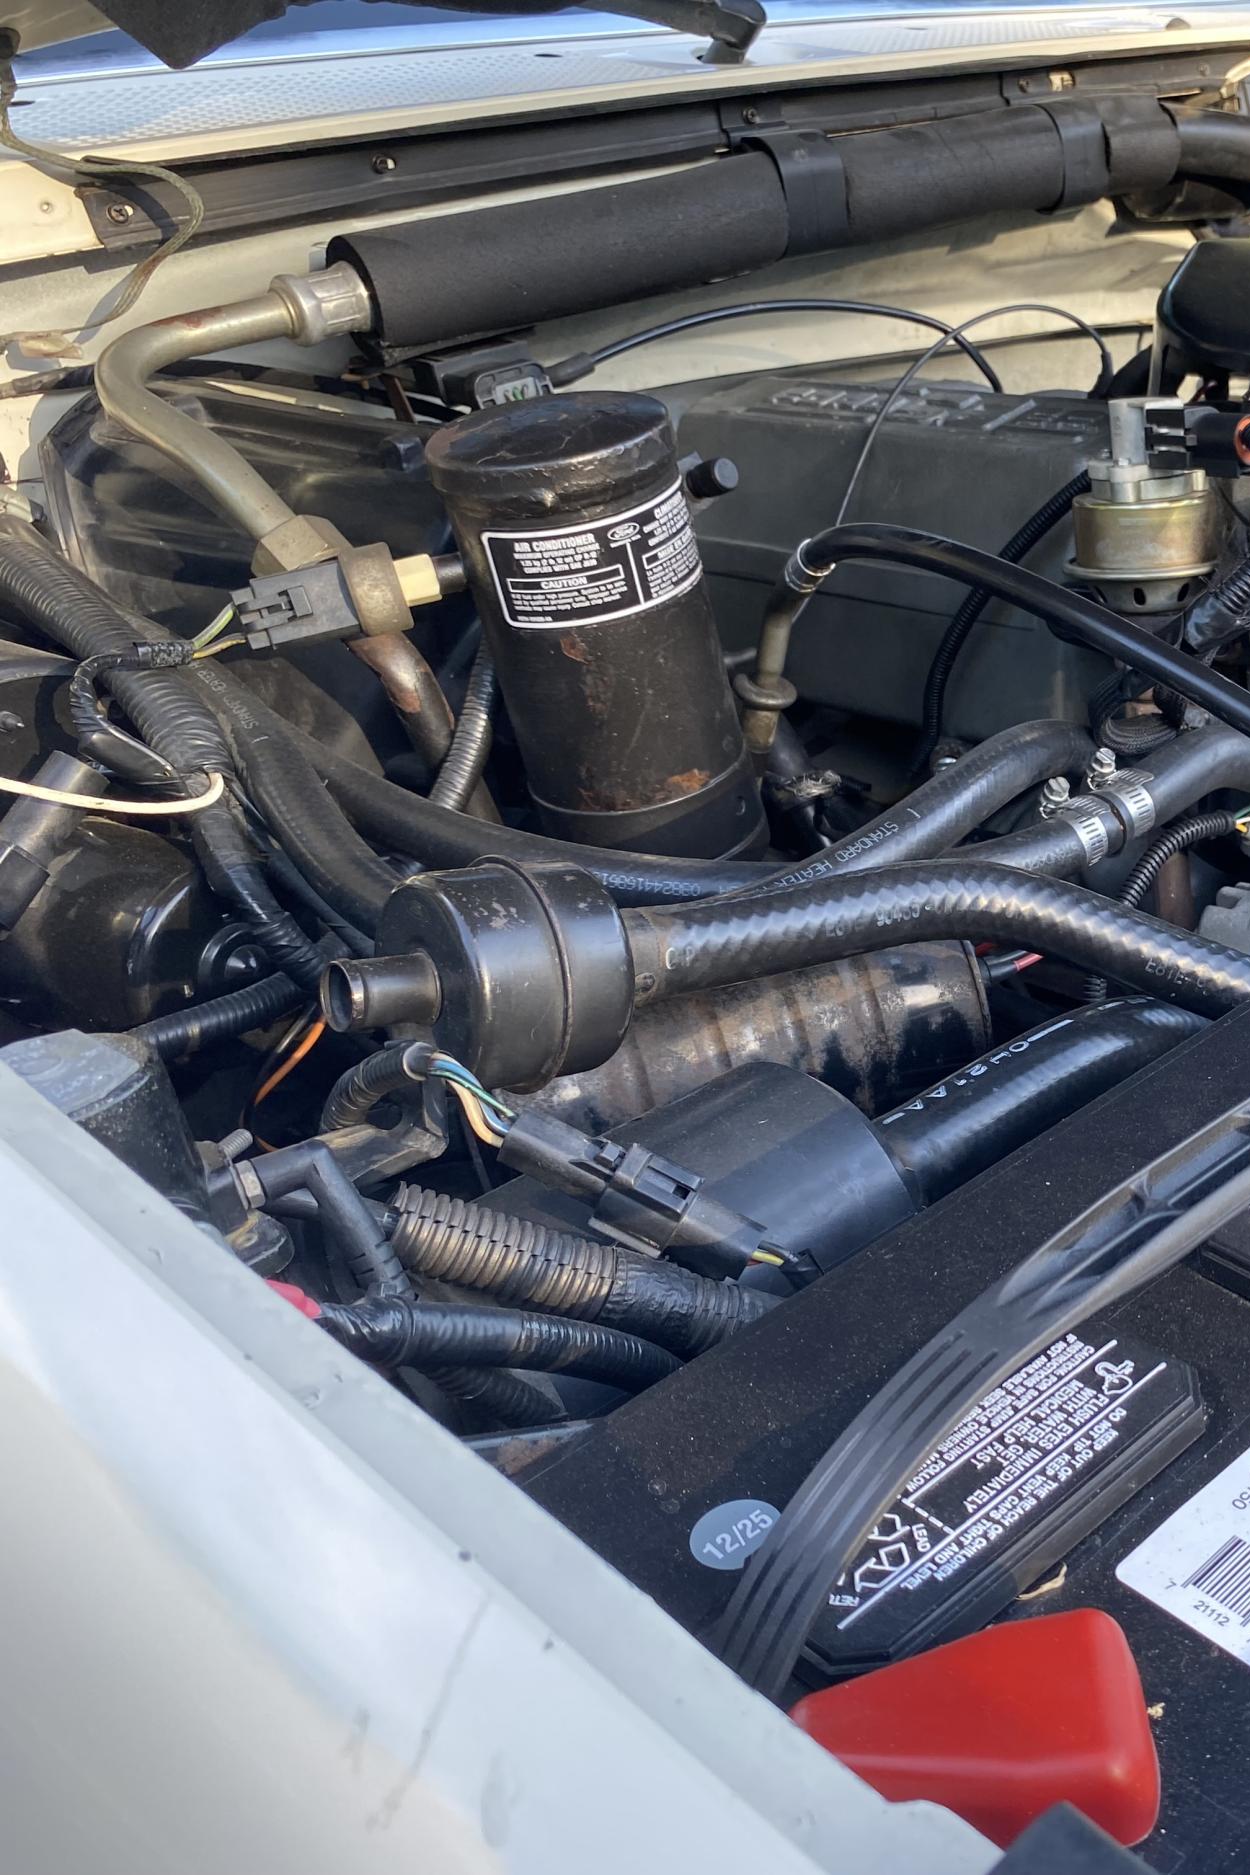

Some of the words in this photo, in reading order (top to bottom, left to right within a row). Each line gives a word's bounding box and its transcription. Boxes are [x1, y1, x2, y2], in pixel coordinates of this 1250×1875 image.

[514, 542, 531, 552] AIR
[533, 534, 597, 551] CONDITIONER
[541, 577, 587, 591] CAUTION
[835, 822, 898, 865] STANDARD
[976, 1395, 1015, 1423] VEHICLE
[1031, 1380, 1083, 1417] MEDICAL
[1060, 1387, 1096, 1416] WITH
[1069, 1394, 1109, 1426] FLUSH
[1109, 1407, 1126, 1421] DO
[1004, 1417, 1035, 1443] HELP
[1020, 1414, 1063, 1443] WATER.
[1039, 1423, 1073, 1449] EYES
[1089, 1420, 1111, 1438] NOT
[1094, 1429, 1118, 1450] KEEP
[943, 1426, 990, 1461] STARTING
[971, 1441, 1004, 1469] FAST
[996, 1444, 1023, 1466] GET
[1046, 1453, 1071, 1475] KEEP
[1071, 1449, 1093, 1468] OUT
[906, 1460, 945, 1491] FOLLOW
[965, 1448, 1041, 1512] IMMEDIATELY
[1018, 1475, 1046, 1497] VENT
[1057, 1466, 1072, 1481] OF
[1033, 1480, 1058, 1498] THE
[989, 1496, 1019, 1519] CAPS
[1000, 1496, 1036, 1526] REACH
[702, 1508, 774, 1560] 12/25
[912, 1523, 930, 1552] LEAD
[959, 1519, 992, 1545] TIGHT
[987, 1524, 1003, 1540] OF
[934, 1537, 986, 1580] CHILDREN
[935, 1543, 959, 1563] AND
[1165, 1579, 1177, 1589] 7
[1193, 1600, 1229, 1626] 21112
